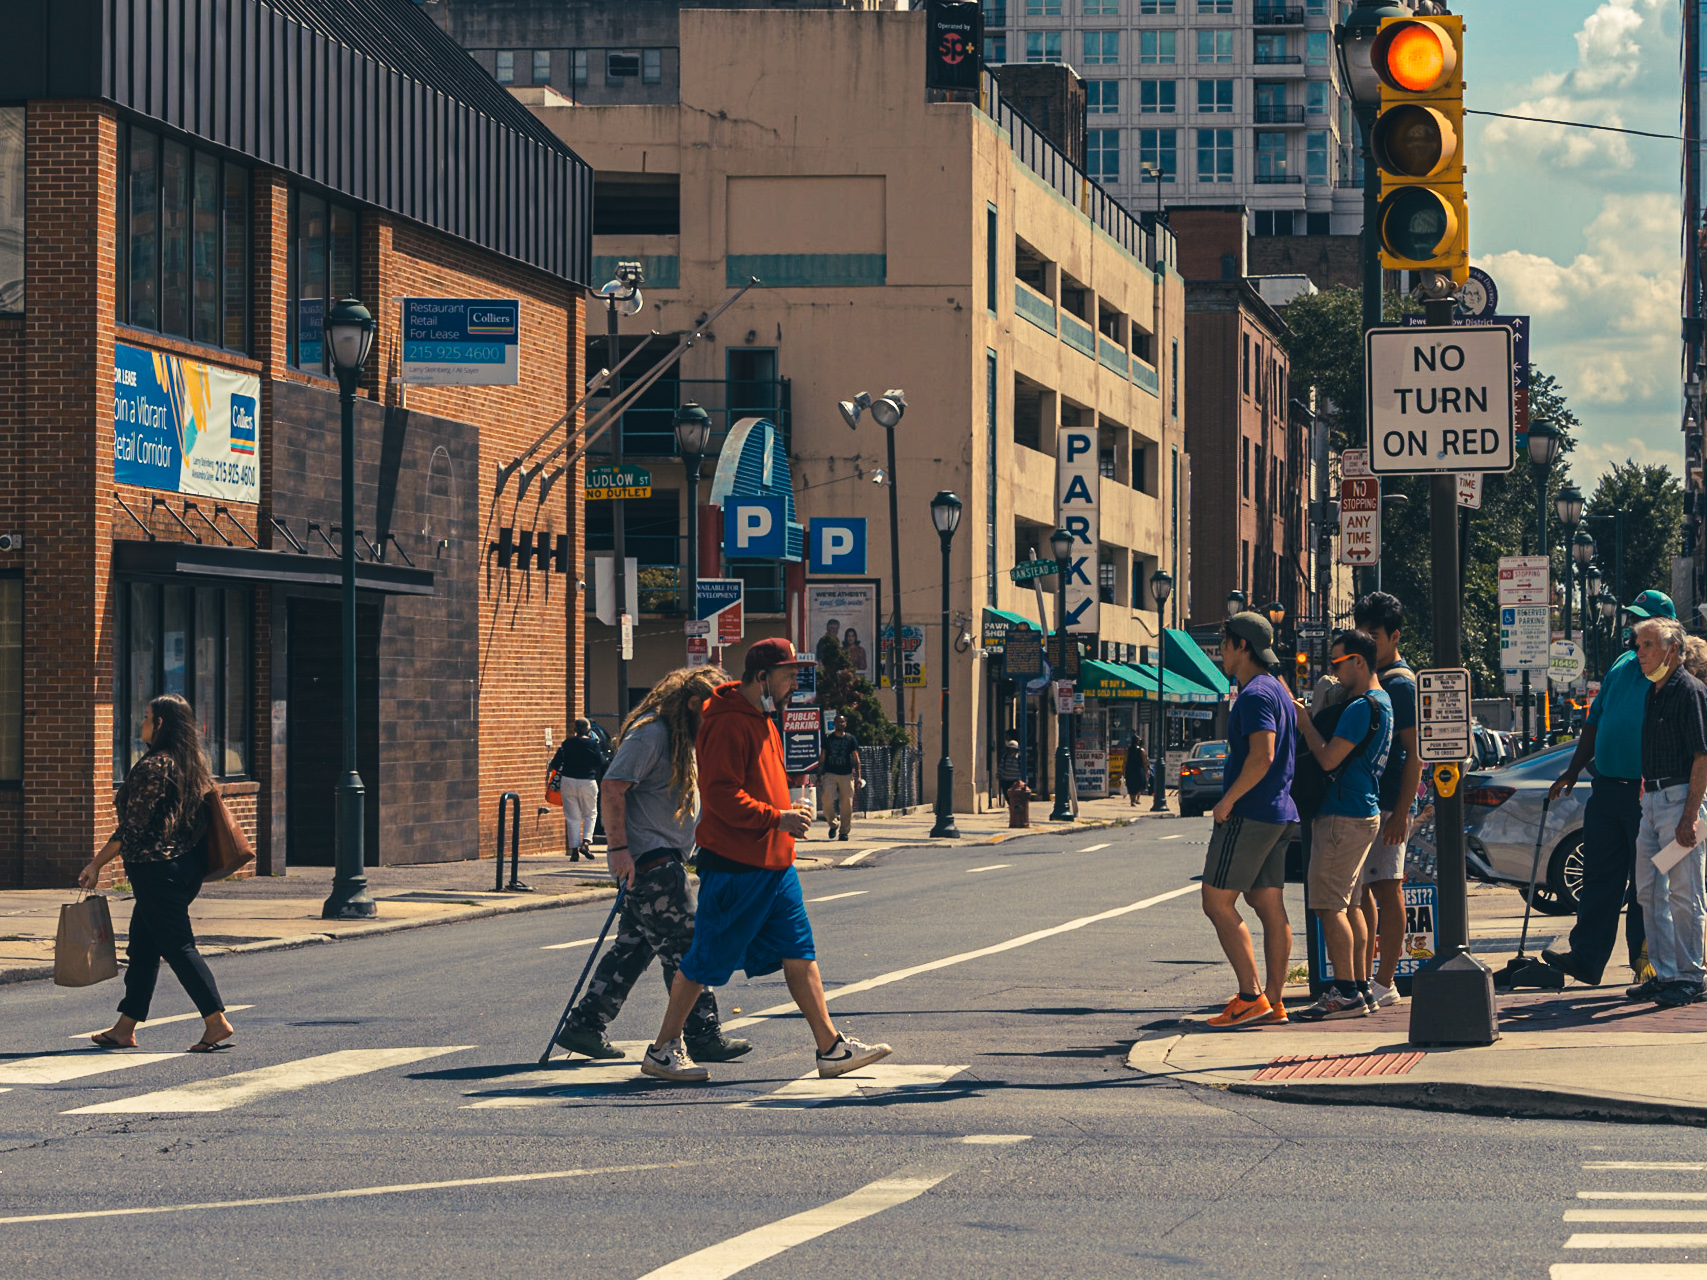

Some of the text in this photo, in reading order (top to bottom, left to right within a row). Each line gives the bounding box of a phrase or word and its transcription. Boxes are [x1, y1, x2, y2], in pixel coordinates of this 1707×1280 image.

[938, 22, 962, 30] Operated
[410, 302, 464, 313] Restaurant
[410, 315, 437, 325] Retail
[473, 312, 510, 323] Colliers
[410, 329, 460, 339] For Lease
[409, 345, 499, 360] 215 925 4600
[1414, 344, 1465, 372] NO
[122, 369, 137, 387] LEASE
[1393, 386, 1487, 414] TURN
[114, 392, 167, 430] oin a Vibrant
[232, 406, 253, 430] Colliers
[1383, 428, 1500, 457] ON RED
[137, 433, 172, 468] Corridor
[215, 460, 226, 483] 215
[228, 462, 239, 485] 925
[241, 465, 255, 487] 4600
[586, 473, 648, 488] LUDLOW ST
[1353, 480, 1367, 497] NO
[1458, 477, 1475, 490] TIME
[586, 488, 647, 498] NO OUTLET
[1063, 434, 1094, 586] PARK
[1342, 498, 1377, 510] STOPPING
[737, 505, 772, 548] P
[1347, 516, 1371, 528] ANY
[1346, 532, 1371, 544] TIME
[821, 527, 854, 565] P
[1010, 565, 1049, 580] RANSTEAD
[1515, 570, 1540, 578] STOPPING
[1516, 608, 1546, 616] RESERVED
[1097, 689, 1111, 697] GOLD
[1117, 689, 1144, 697] DIAMONDS
[786, 711, 816, 721] PUBLIC
[784, 721, 819, 731] PARKING
